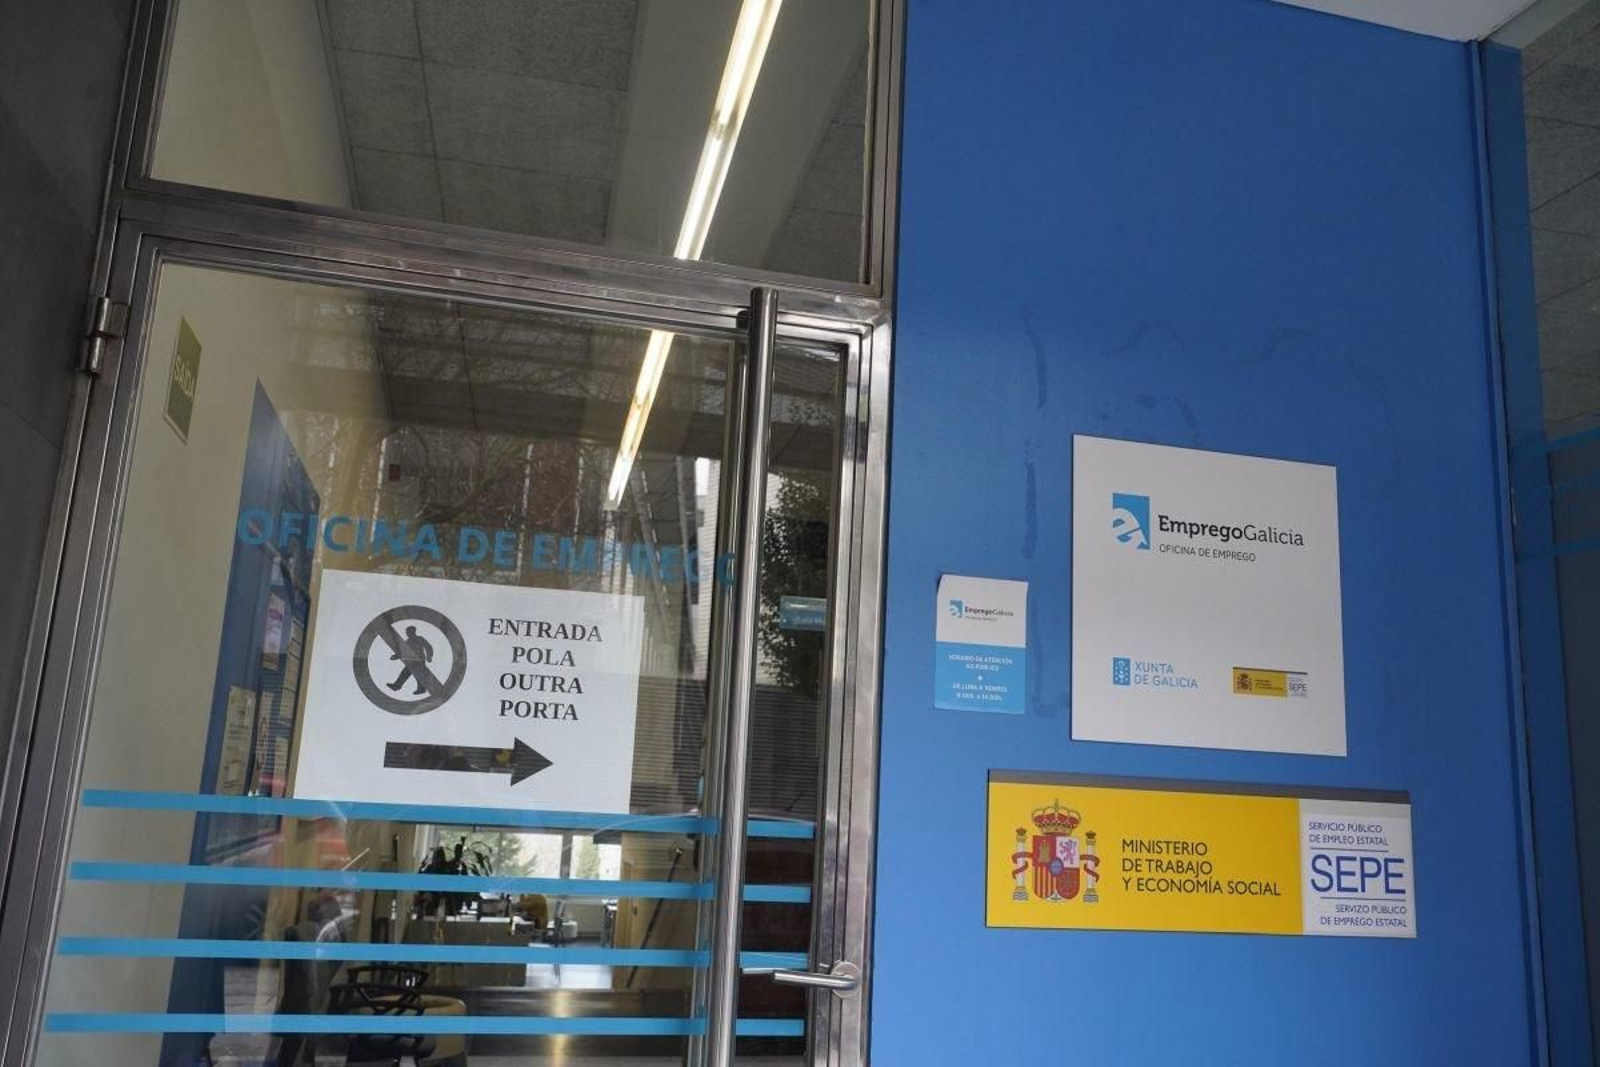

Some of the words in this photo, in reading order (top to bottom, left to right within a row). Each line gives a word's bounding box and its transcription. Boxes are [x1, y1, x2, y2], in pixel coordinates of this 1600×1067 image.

[237, 508, 443, 562] OFICINA
[457, 524, 517, 568] DE
[1157, 514, 1305, 546] EmpregoGalicia
[1159, 543, 1196, 557] OFICINA
[1198, 547, 1212, 558] DE
[1212, 549, 1257, 562] EMPREGO
[488, 618, 603, 642] ENTRADA
[511, 646, 576, 667] POLA
[1134, 661, 1174, 674] XUNTA
[499, 672, 583, 694] OUTRA
[1134, 674, 1148, 685] DE
[1152, 675, 1199, 689] GALICIA
[1288, 682, 1307, 692] SEPE
[499, 699, 579, 721] PORTA
[1308, 822, 1345, 832] SERVICIO
[1347, 821, 1383, 833] PÚBLICO
[1122, 839, 1207, 856] MINISTERIO
[1309, 834, 1320, 844] DE
[1322, 835, 1354, 845] EMPLEO
[1356, 836, 1389, 846] ESTATAL
[1122, 858, 1142, 872] DE
[1145, 858, 1213, 878] TRABAJO
[1310, 853, 1406, 894] SEPE
[1122, 877, 1132, 892] Y
[1136, 877, 1223, 894] ECONOMÍA
[1227, 880, 1281, 896] SOCIAL
[1336, 904, 1370, 914] SERVIZO
[1320, 916, 1331, 925] DE
[1334, 917, 1373, 927] EMPREGO
[1375, 918, 1408, 927] ESTATAL
